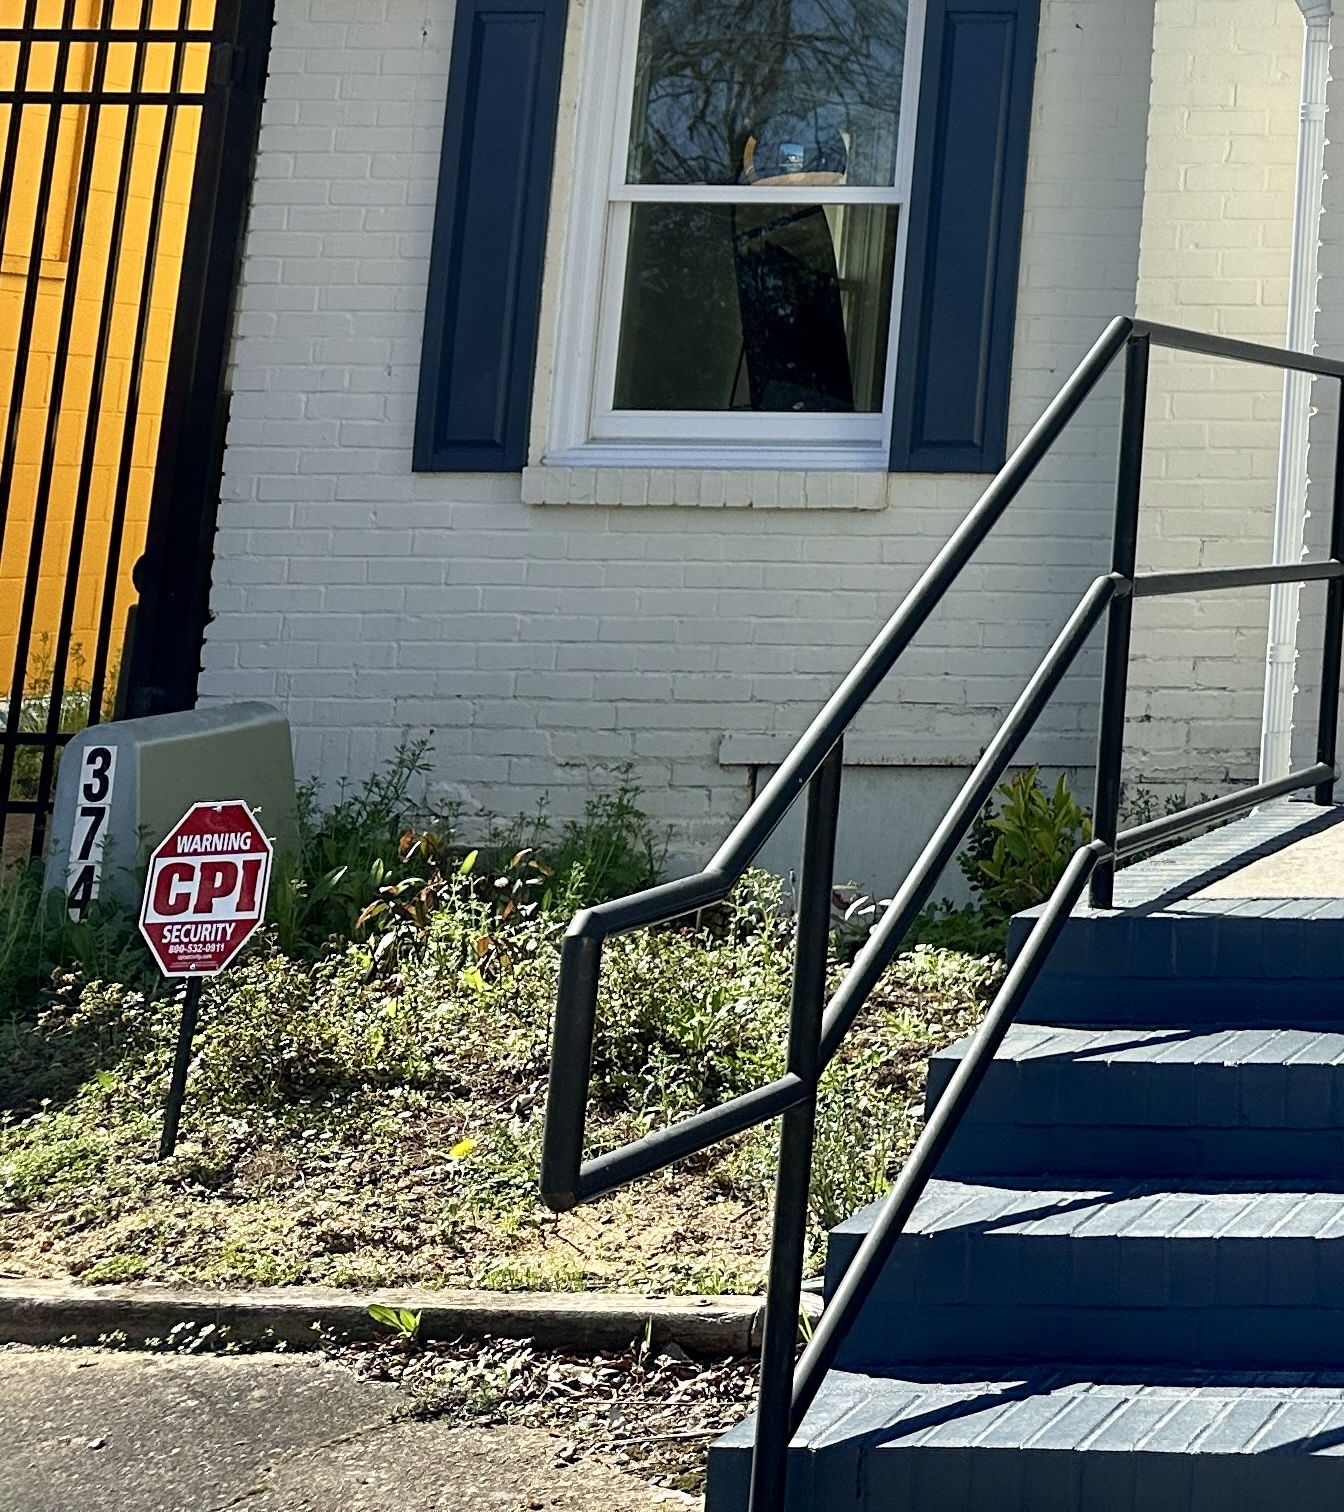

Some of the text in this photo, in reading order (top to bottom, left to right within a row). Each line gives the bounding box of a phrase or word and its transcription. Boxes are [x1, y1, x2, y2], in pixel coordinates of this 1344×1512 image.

[176, 832, 252, 853] WARNING
[153, 859, 262, 916] CPI
[161, 922, 236, 943] SECURITY
